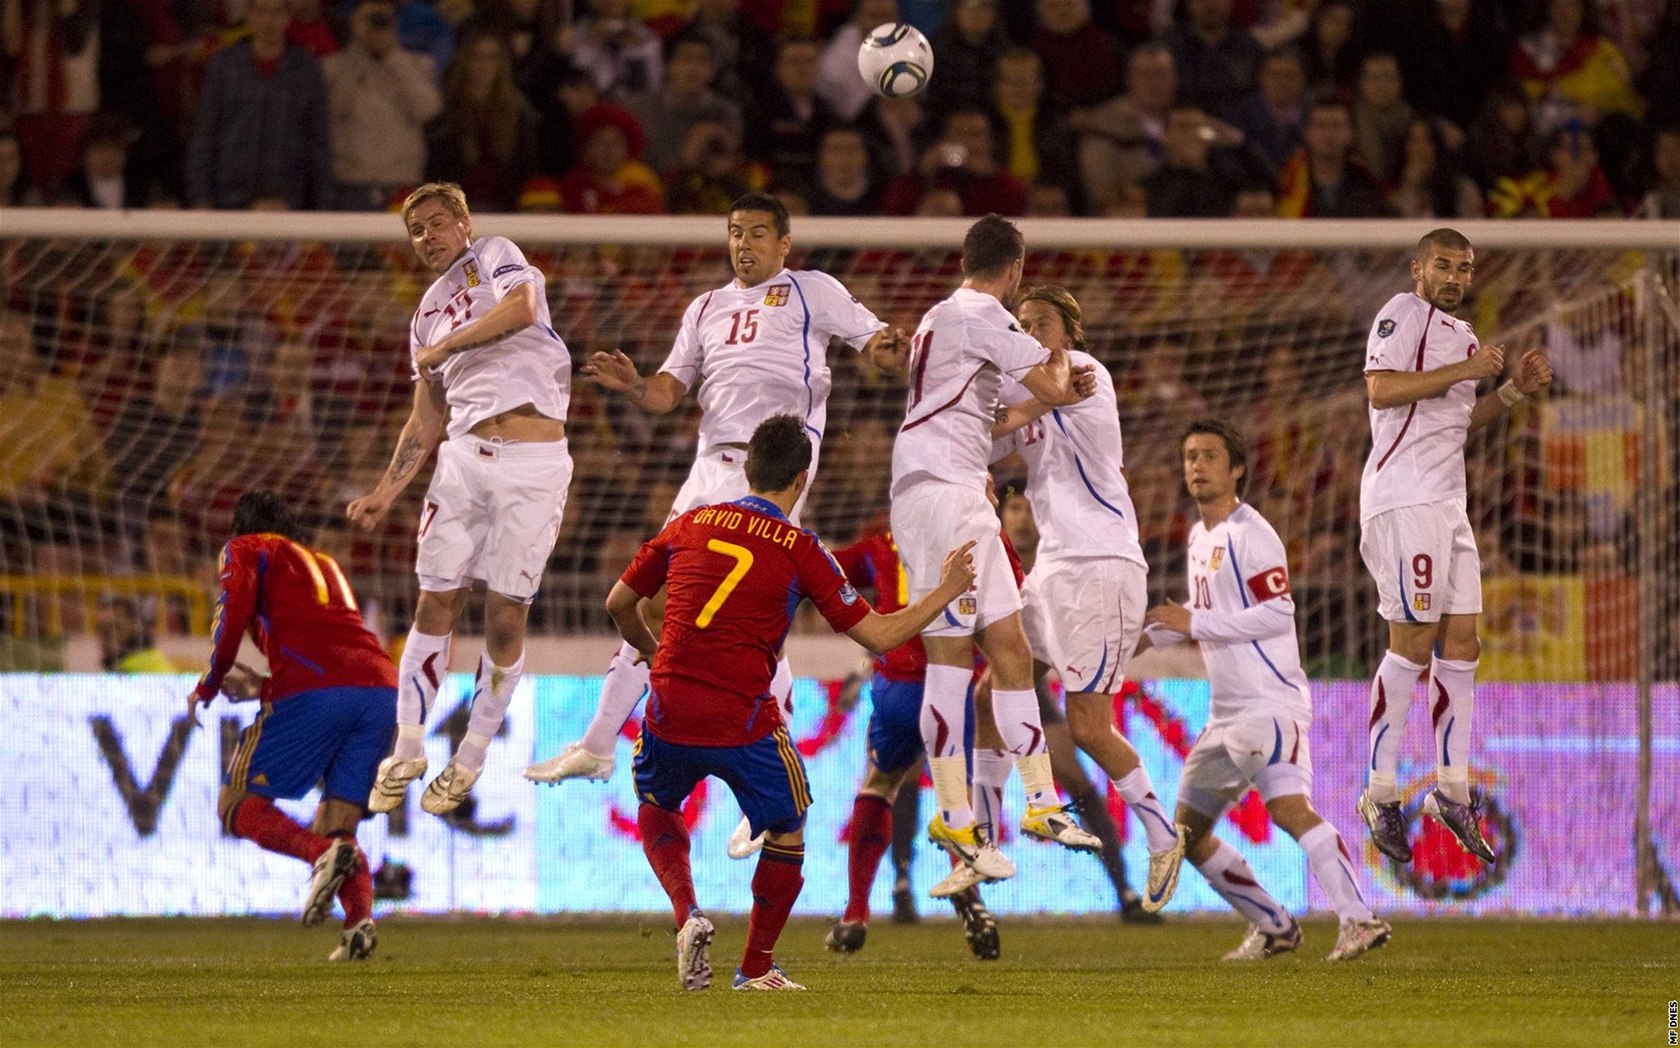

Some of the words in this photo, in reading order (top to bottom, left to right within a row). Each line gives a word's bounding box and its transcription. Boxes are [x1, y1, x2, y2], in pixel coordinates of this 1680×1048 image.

[444, 290, 473, 331] 17
[725, 309, 759, 345] 15
[693, 509, 743, 530] DAVID
[747, 516, 798, 549] VILLA
[290, 541, 357, 612] 11
[695, 538, 754, 629] 7
[1266, 571, 1287, 593] C
[1412, 553, 1433, 589] 9
[1194, 575, 1212, 610] 10
